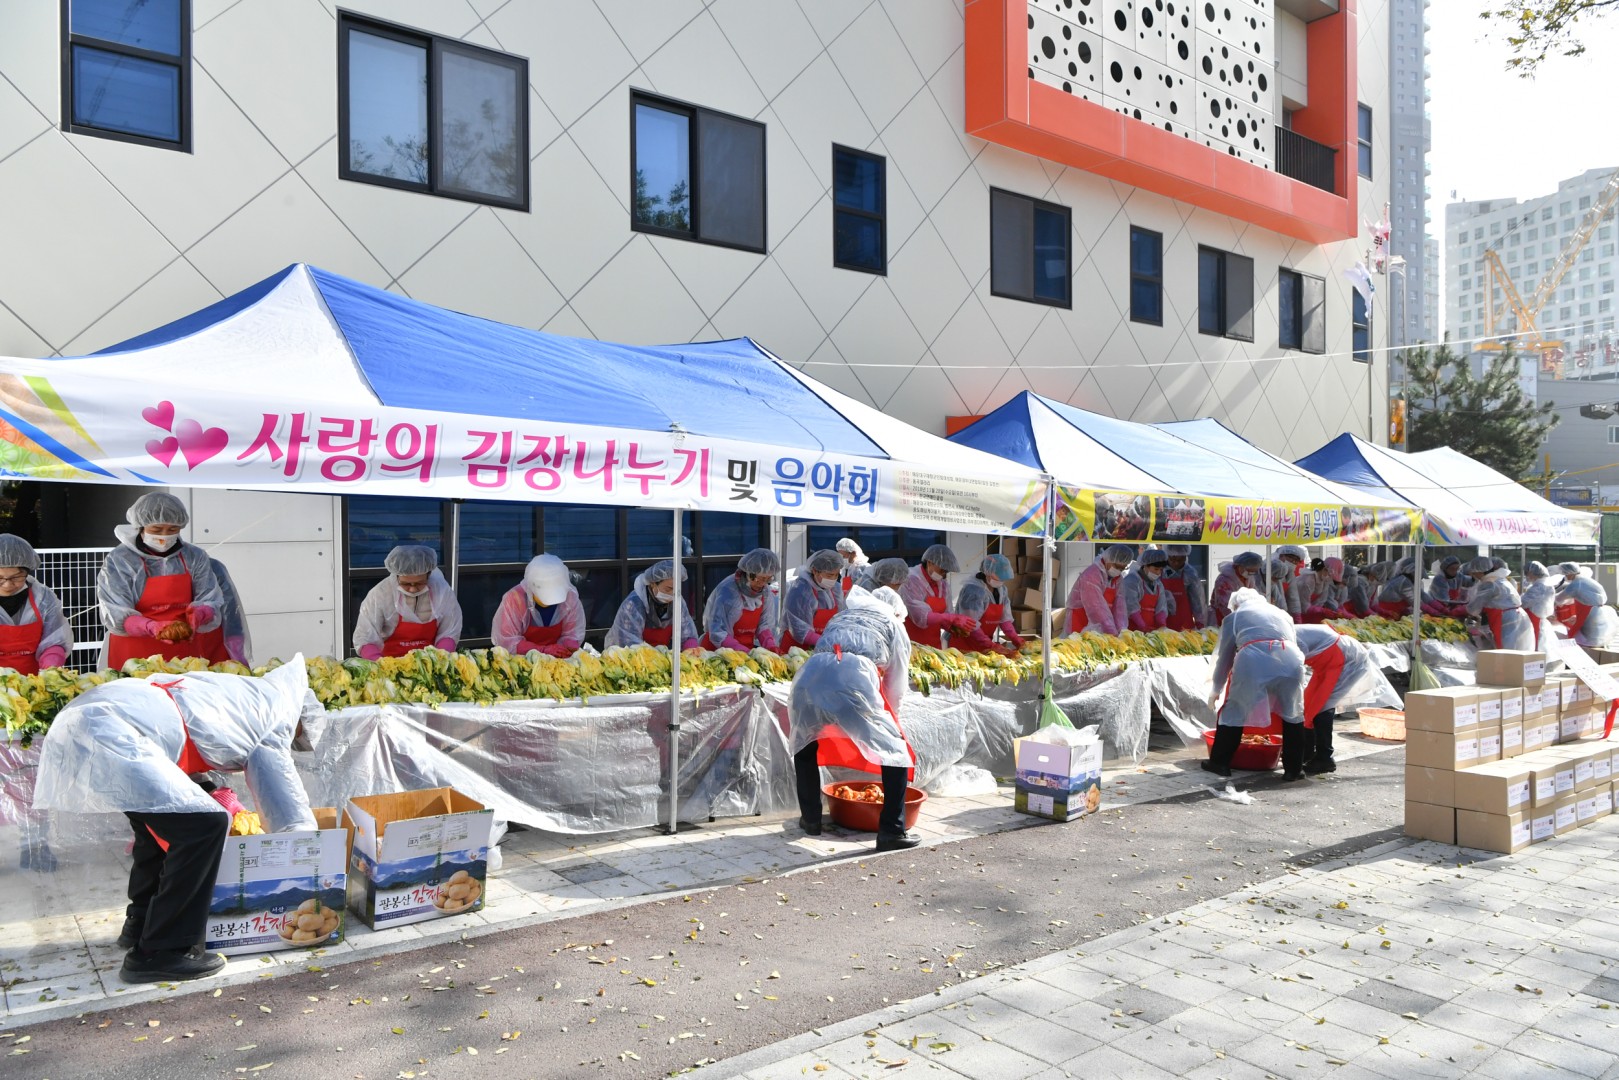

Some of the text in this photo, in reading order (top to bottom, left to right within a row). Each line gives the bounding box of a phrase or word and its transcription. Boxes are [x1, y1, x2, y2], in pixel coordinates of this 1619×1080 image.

[237, 411, 879, 514] 사랑의 김장나누기 및 음악회
[1223, 505, 1338, 538] 사랑의 김장나누기 및 음악회
[272, 905, 284, 914] 서산
[379, 885, 444, 911] 팔봉산 감자
[210, 912, 294, 938] 팔봉산 감자
